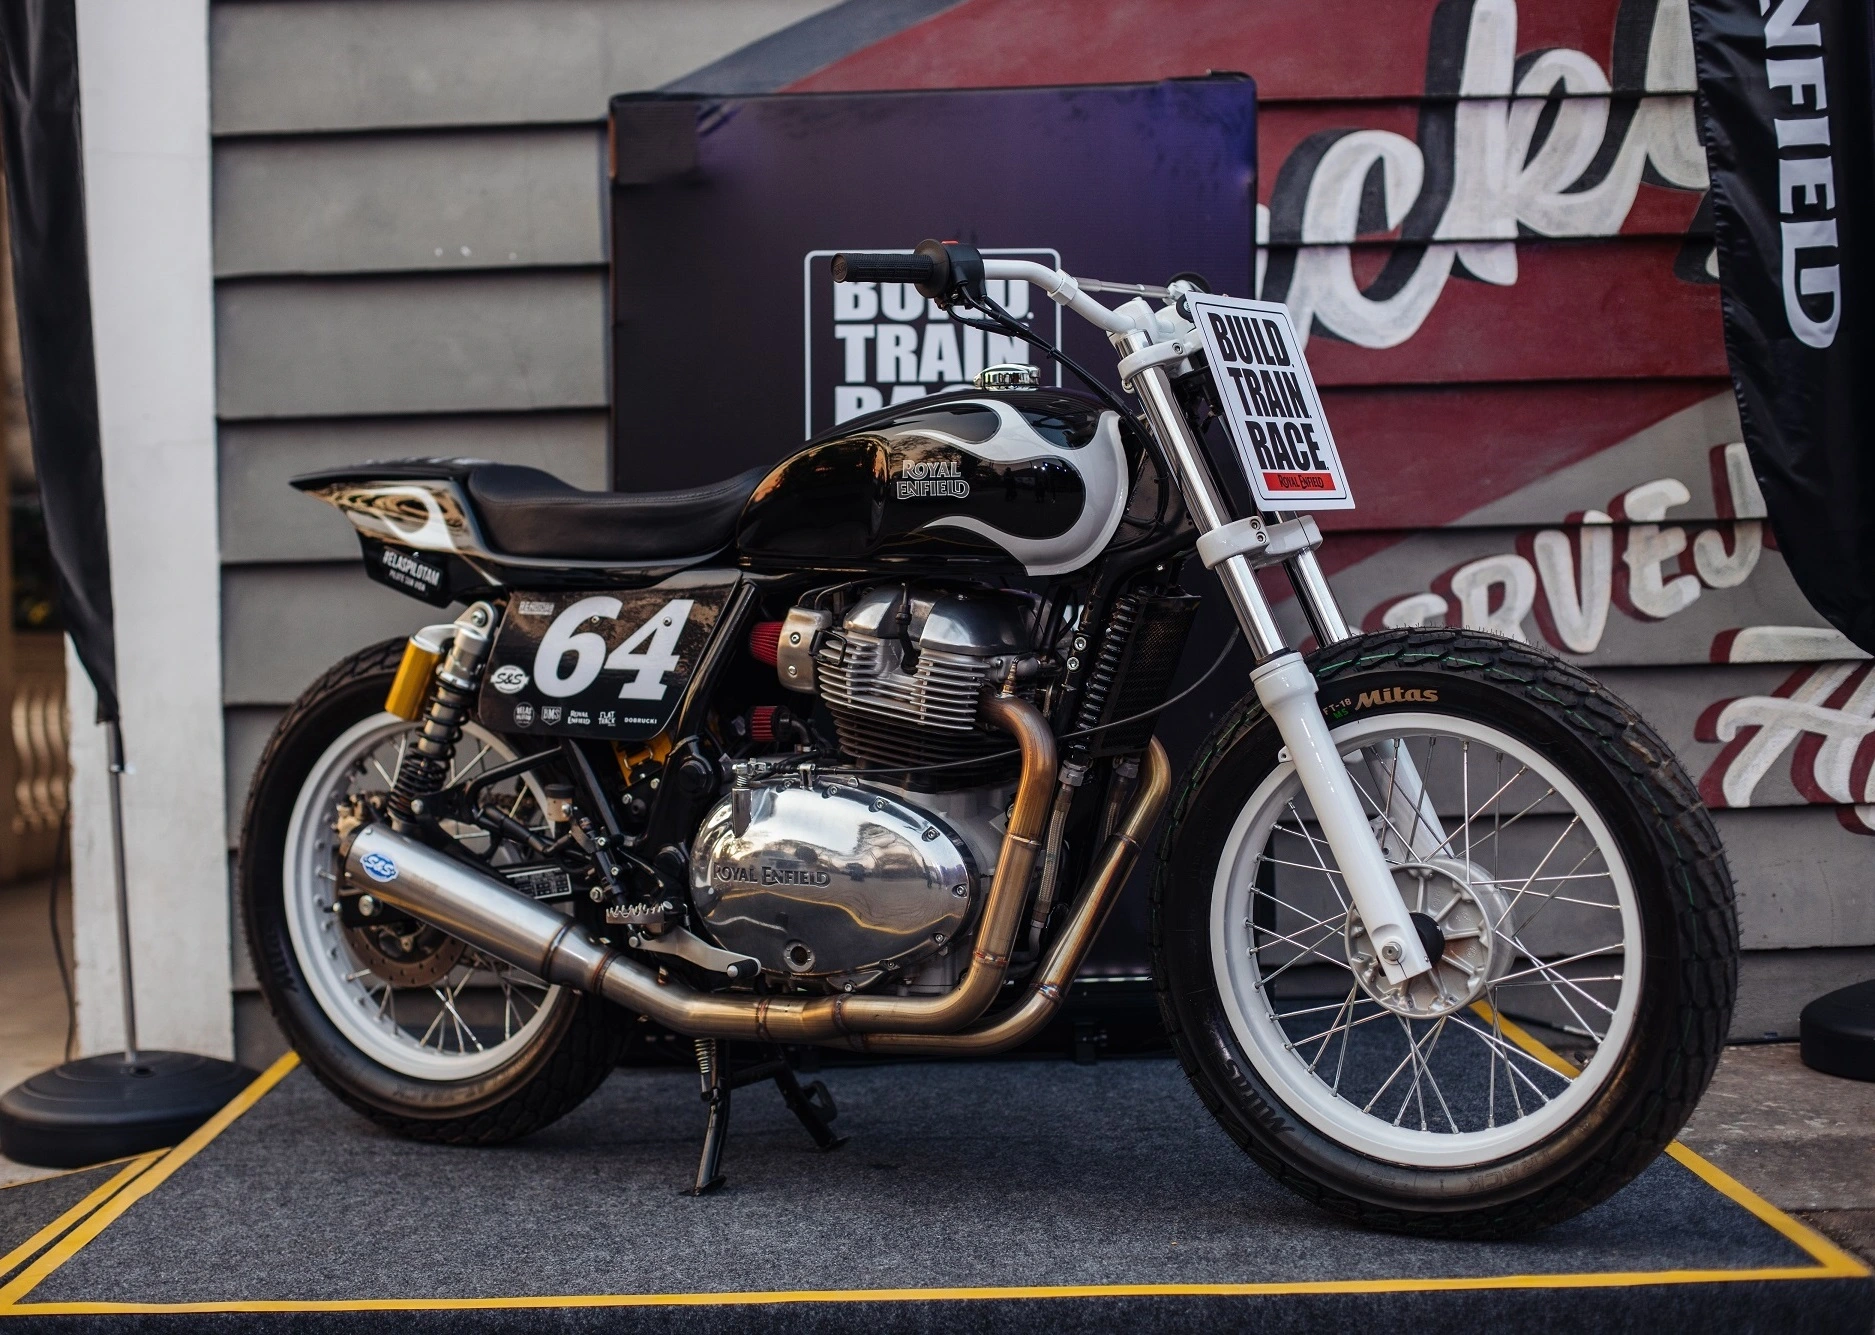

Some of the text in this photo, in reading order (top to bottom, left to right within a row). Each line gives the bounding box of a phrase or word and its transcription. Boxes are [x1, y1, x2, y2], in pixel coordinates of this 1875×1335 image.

[1207, 312, 1295, 368] BUILD.
[1226, 366, 1312, 419] TRAIN.
[1245, 420, 1329, 471] RACE.
[902, 459, 961, 479] ROYAL
[897, 479, 970, 499] ENFIELD
[1278, 474, 1324, 489] ROYAL ENFIELD
[533, 596, 695, 701] 64
[495, 673, 523, 685] S&S
[1355, 686, 1439, 711] Mitas
[543, 708, 560, 720] BMS
[363, 855, 396, 877] S&S
[713, 862, 831, 888] ROYAL ENFIELD
